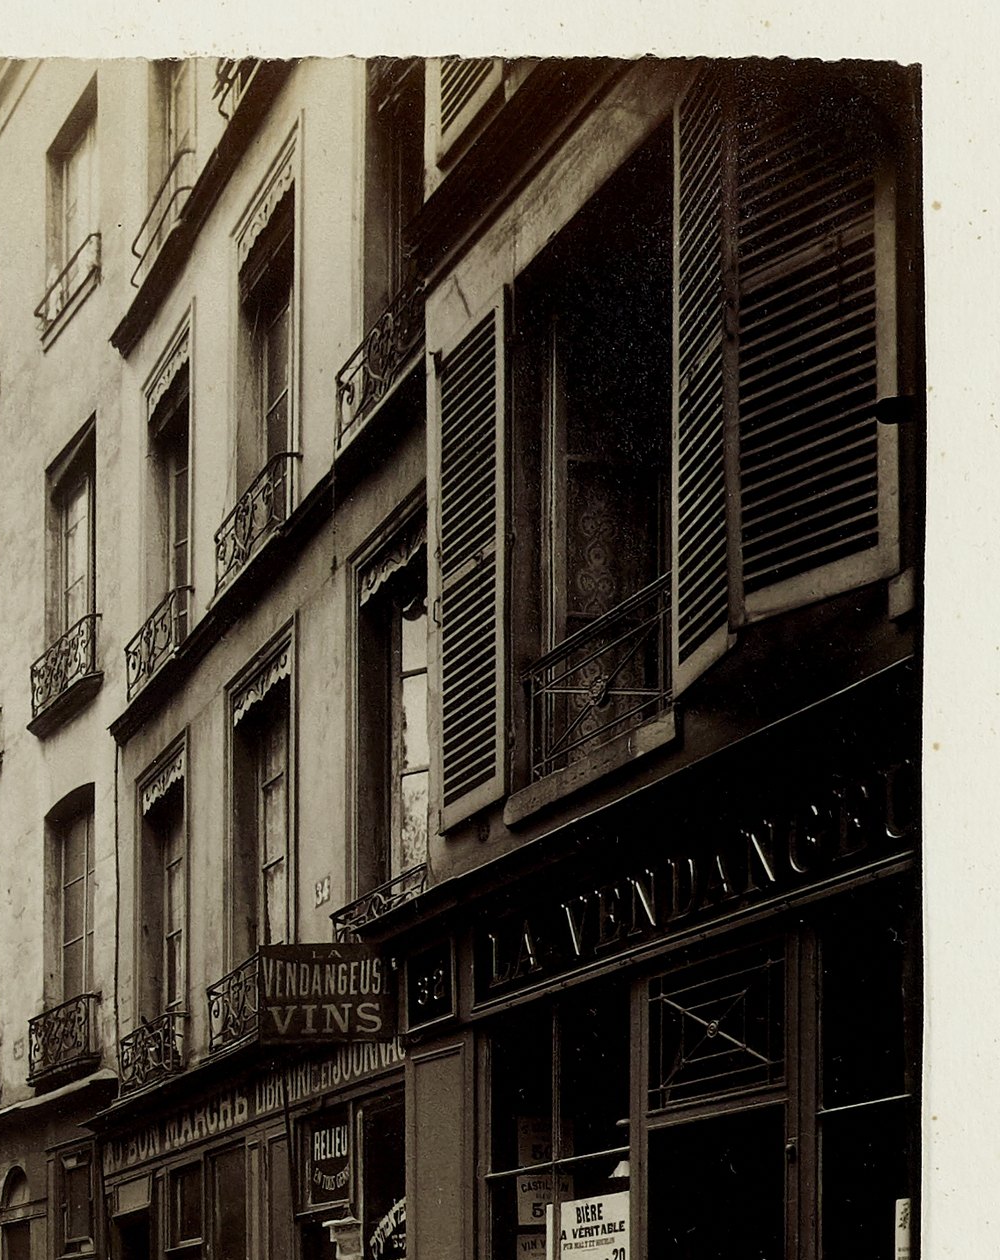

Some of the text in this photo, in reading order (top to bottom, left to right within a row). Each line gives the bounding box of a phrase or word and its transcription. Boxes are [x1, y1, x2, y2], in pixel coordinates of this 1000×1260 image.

[488, 764, 913, 989] LA VENDANGEU
[312, 950, 342, 959] LA
[268, 1003, 383, 1034] VINS
[333, 1036, 407, 1085] JOURNAU
[314, 1124, 348, 1161] RELIEU
[576, 1203, 603, 1224] BIÈRE
[572, 1220, 626, 1239] VÉRITABLE
[521, 1239, 537, 1251] VIN
